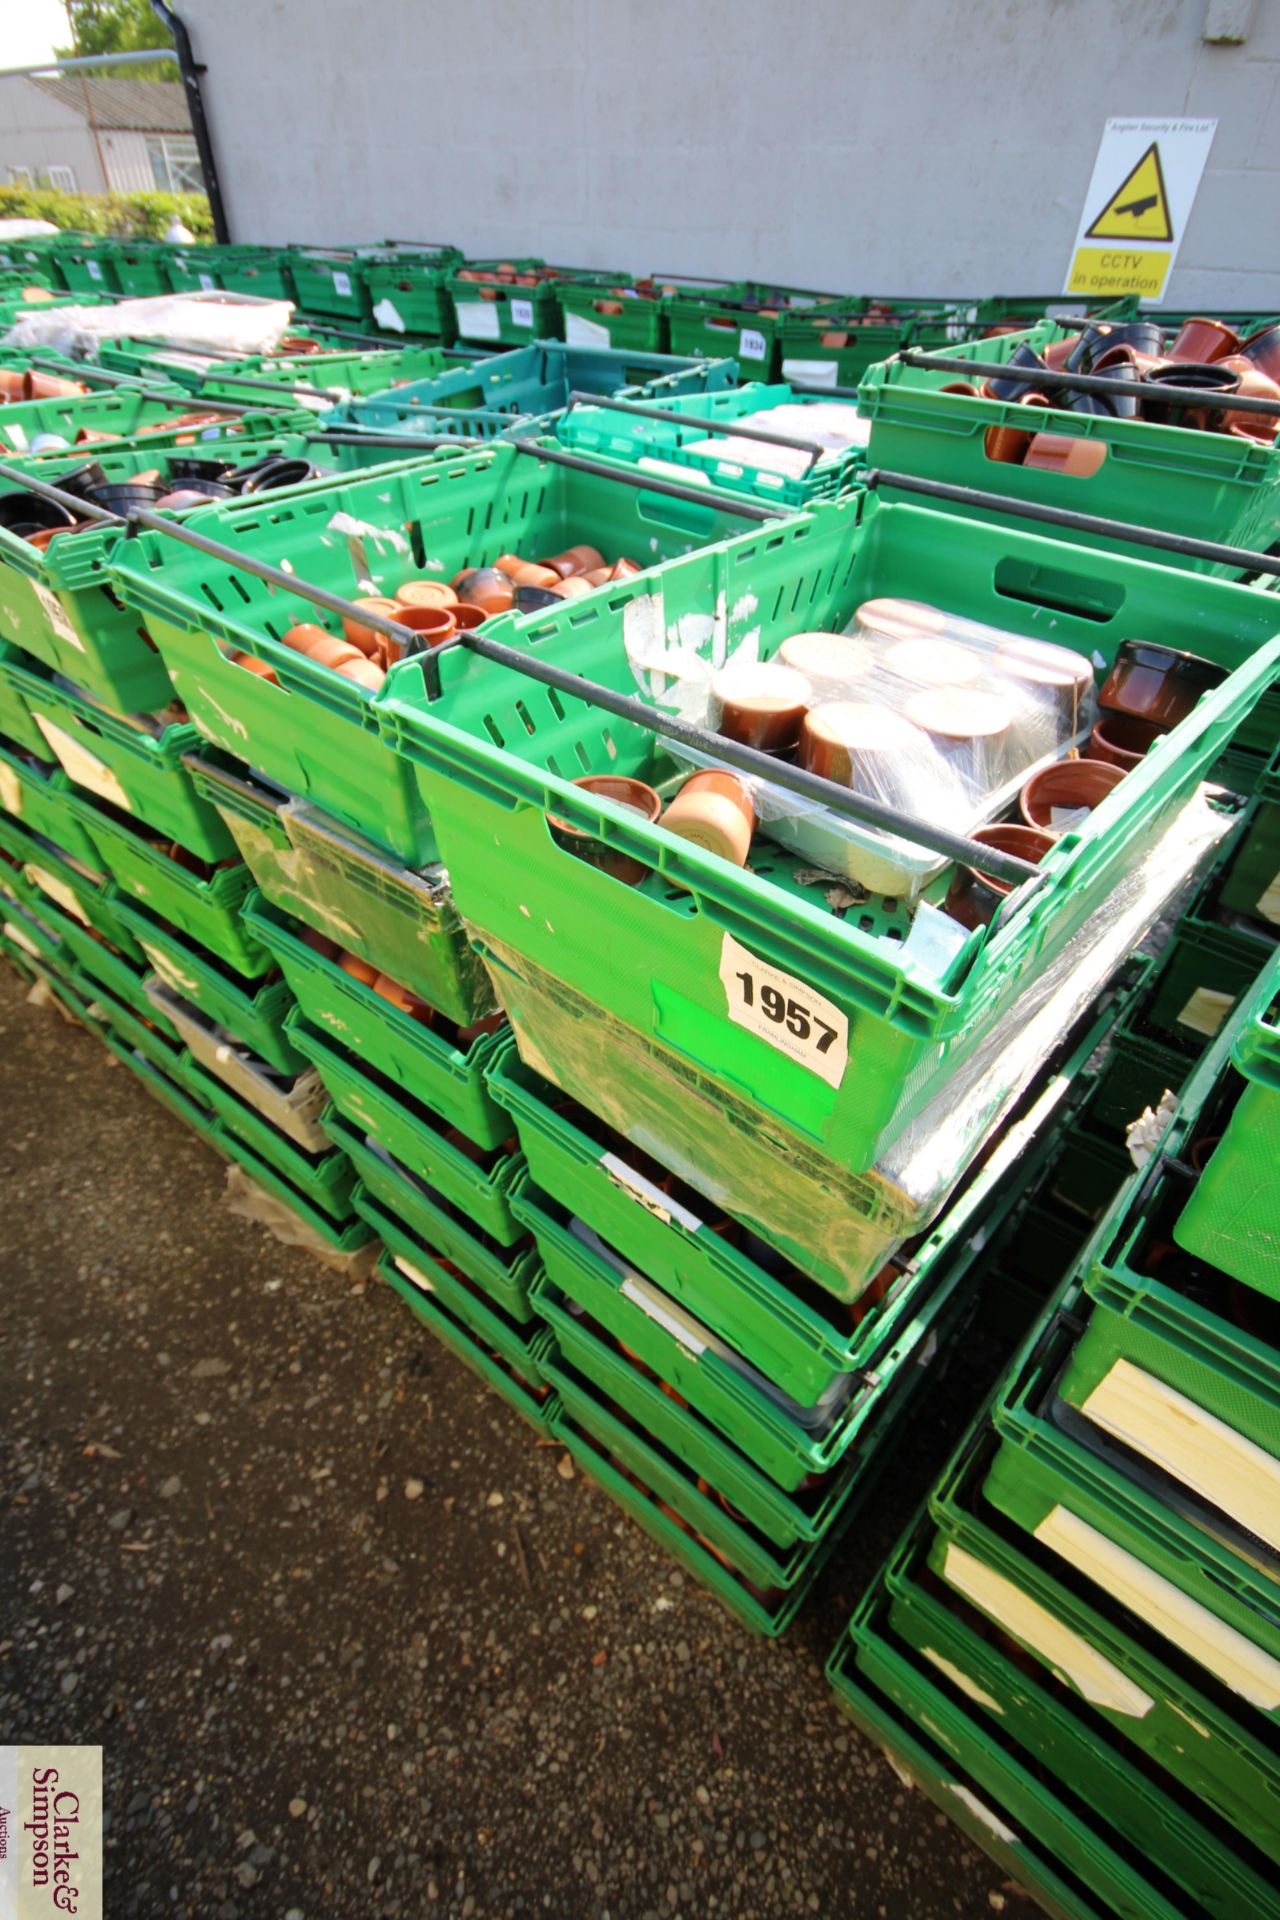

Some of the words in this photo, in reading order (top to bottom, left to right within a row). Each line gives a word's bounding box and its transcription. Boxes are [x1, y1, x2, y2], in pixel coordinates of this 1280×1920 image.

[1140, 122, 1170, 133] Security
[1100, 253, 1143, 269] CCTV
[1073, 272, 1086, 285] in
[1090, 274, 1159, 291] operation
[736, 972, 838, 1054] 1957
